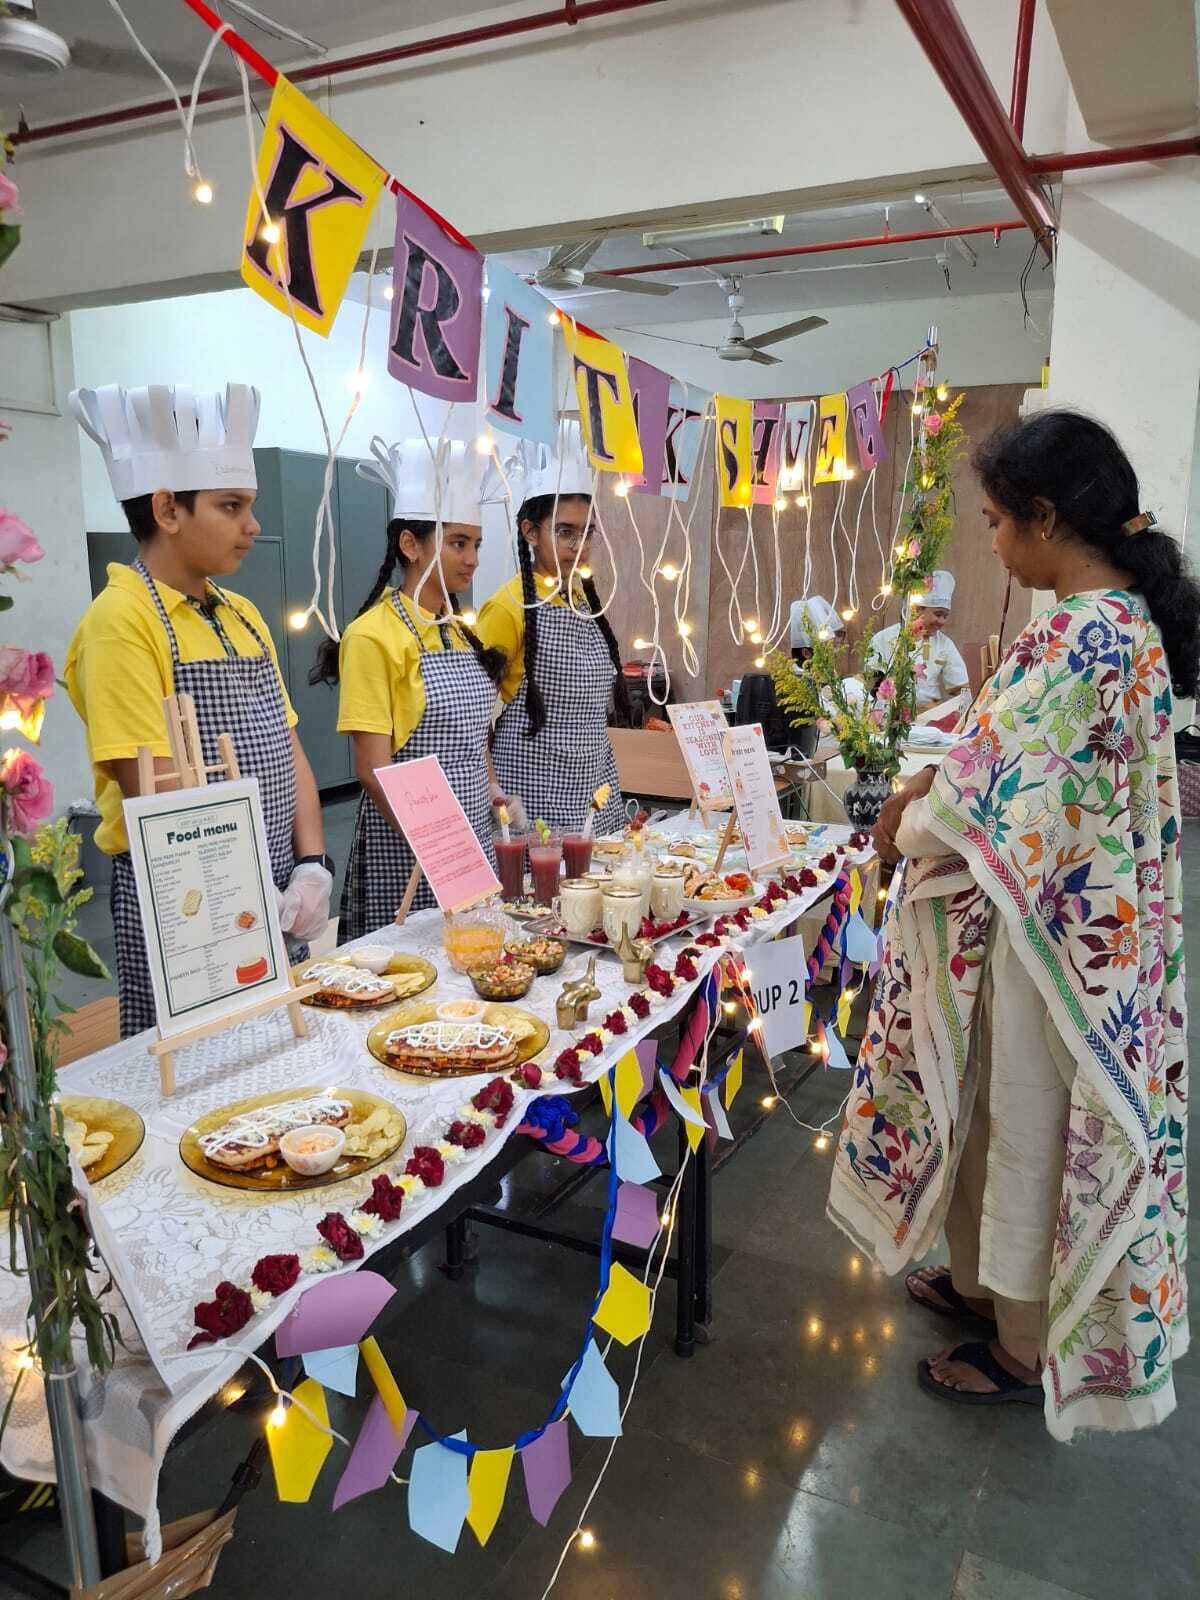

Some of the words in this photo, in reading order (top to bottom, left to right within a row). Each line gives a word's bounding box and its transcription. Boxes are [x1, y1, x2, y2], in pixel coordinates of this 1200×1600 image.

[682, 719, 716, 730] KITCHEN
[166, 826, 201, 845] Food
[203, 822, 238, 837] menu
[788, 979, 799, 1005] 2
